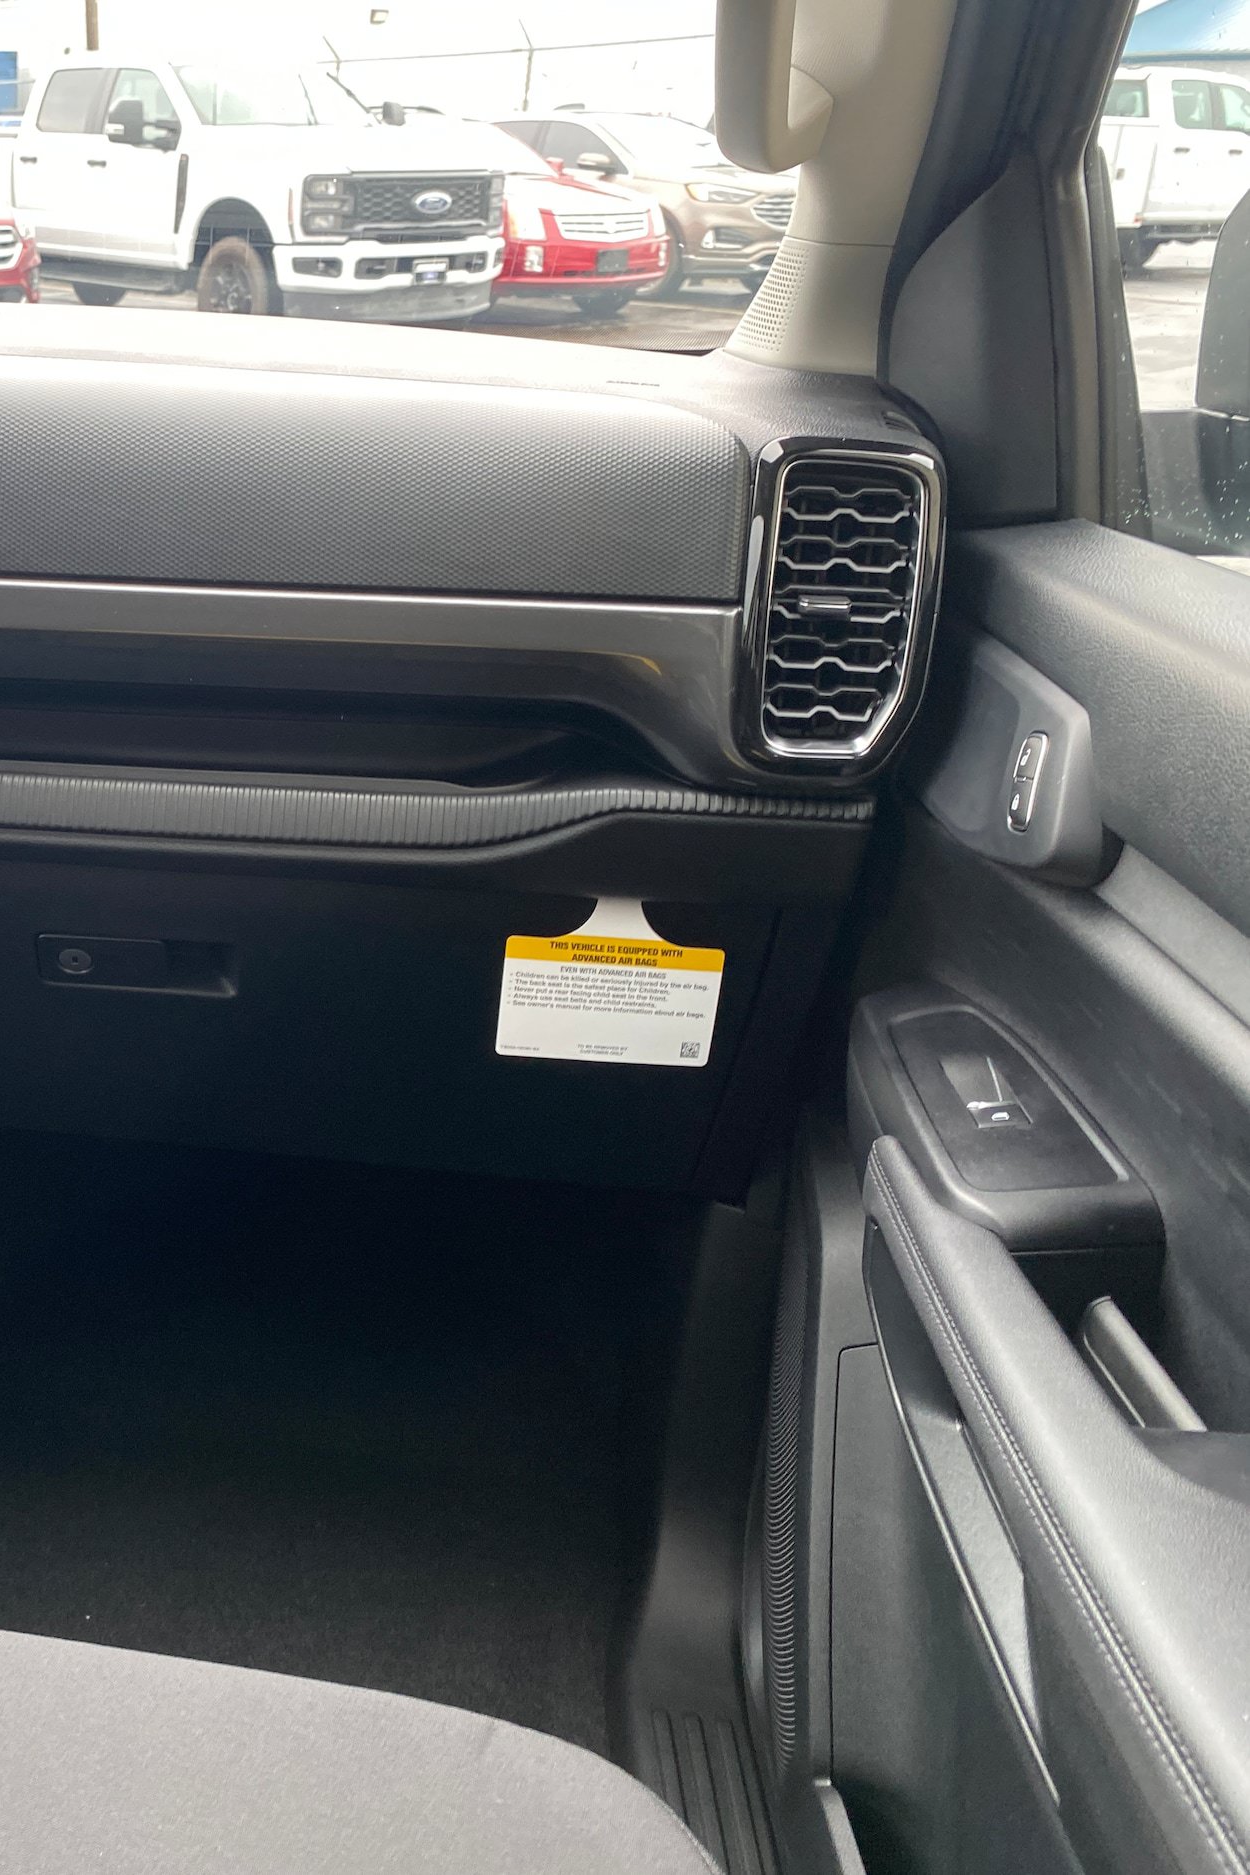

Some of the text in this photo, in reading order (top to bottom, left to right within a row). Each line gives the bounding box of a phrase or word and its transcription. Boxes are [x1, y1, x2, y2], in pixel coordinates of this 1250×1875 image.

[550, 941, 683, 958] THIS VEHICLE IS EQUIPPED WITH
[572, 954, 658, 966] ADVANCED AIR BAGS
[598, 969, 633, 977] ADVANCED
